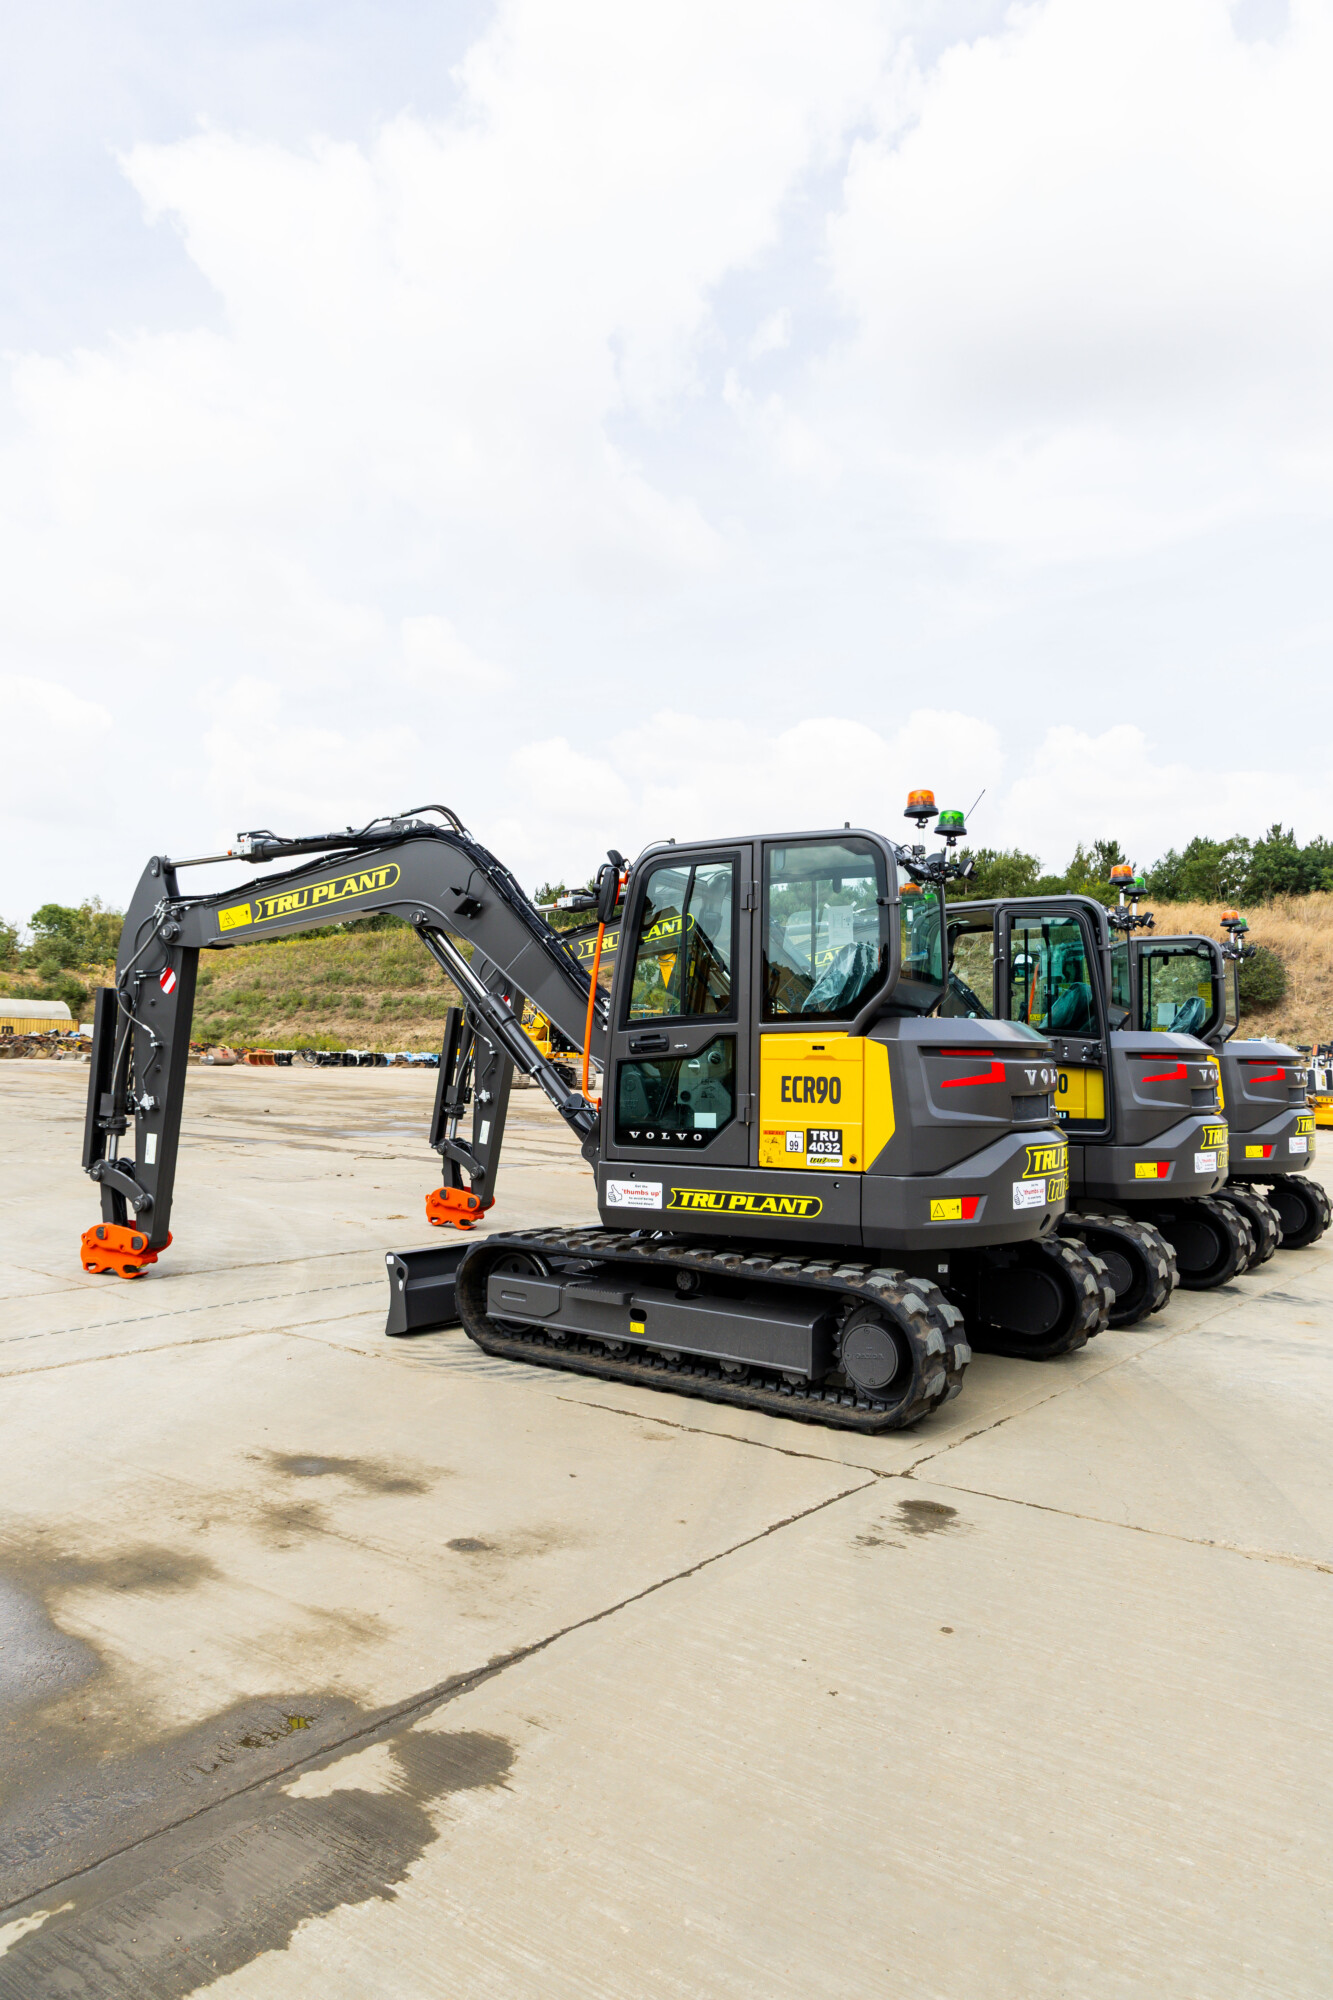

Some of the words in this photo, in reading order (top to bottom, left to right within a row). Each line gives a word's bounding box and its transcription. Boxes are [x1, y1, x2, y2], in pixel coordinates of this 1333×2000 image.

[264, 890, 308, 916] TRU
[312, 869, 390, 904] PLANT
[781, 1075, 842, 1105] ECR90
[629, 1130, 703, 1141] VOLVO
[810, 1130, 839, 1142] TRU
[789, 1140, 799, 1151] 99
[808, 1142, 841, 1153] 4032
[1033, 1149, 1060, 1171] TRU
[679, 1191, 725, 1208] TRU
[728, 1195, 813, 1214] PLANT
